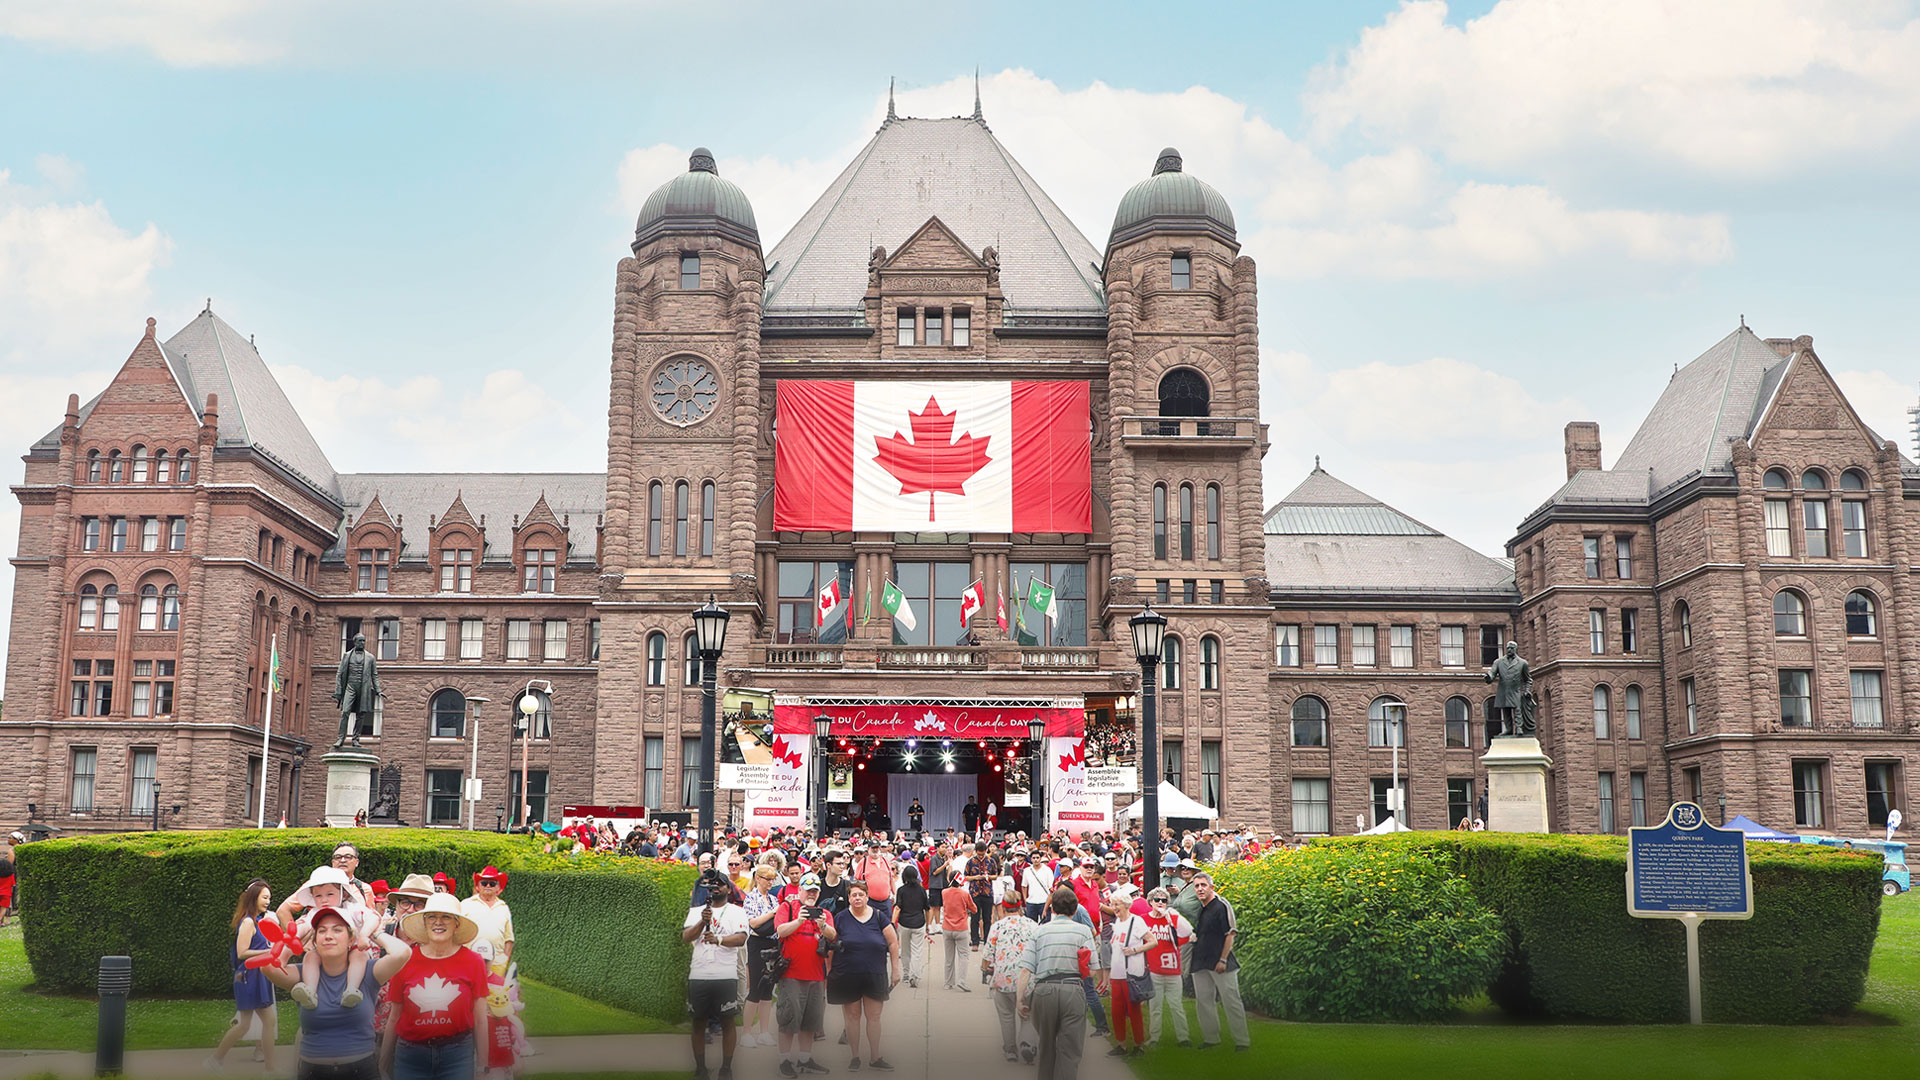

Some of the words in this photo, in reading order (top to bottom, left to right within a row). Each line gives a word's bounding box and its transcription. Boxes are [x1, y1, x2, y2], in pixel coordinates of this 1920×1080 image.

[838, 716, 852, 724] DU
[852, 710, 905, 732] Canada
[954, 711, 1008, 733] Canada
[415, 1017, 452, 1025] CANADA
